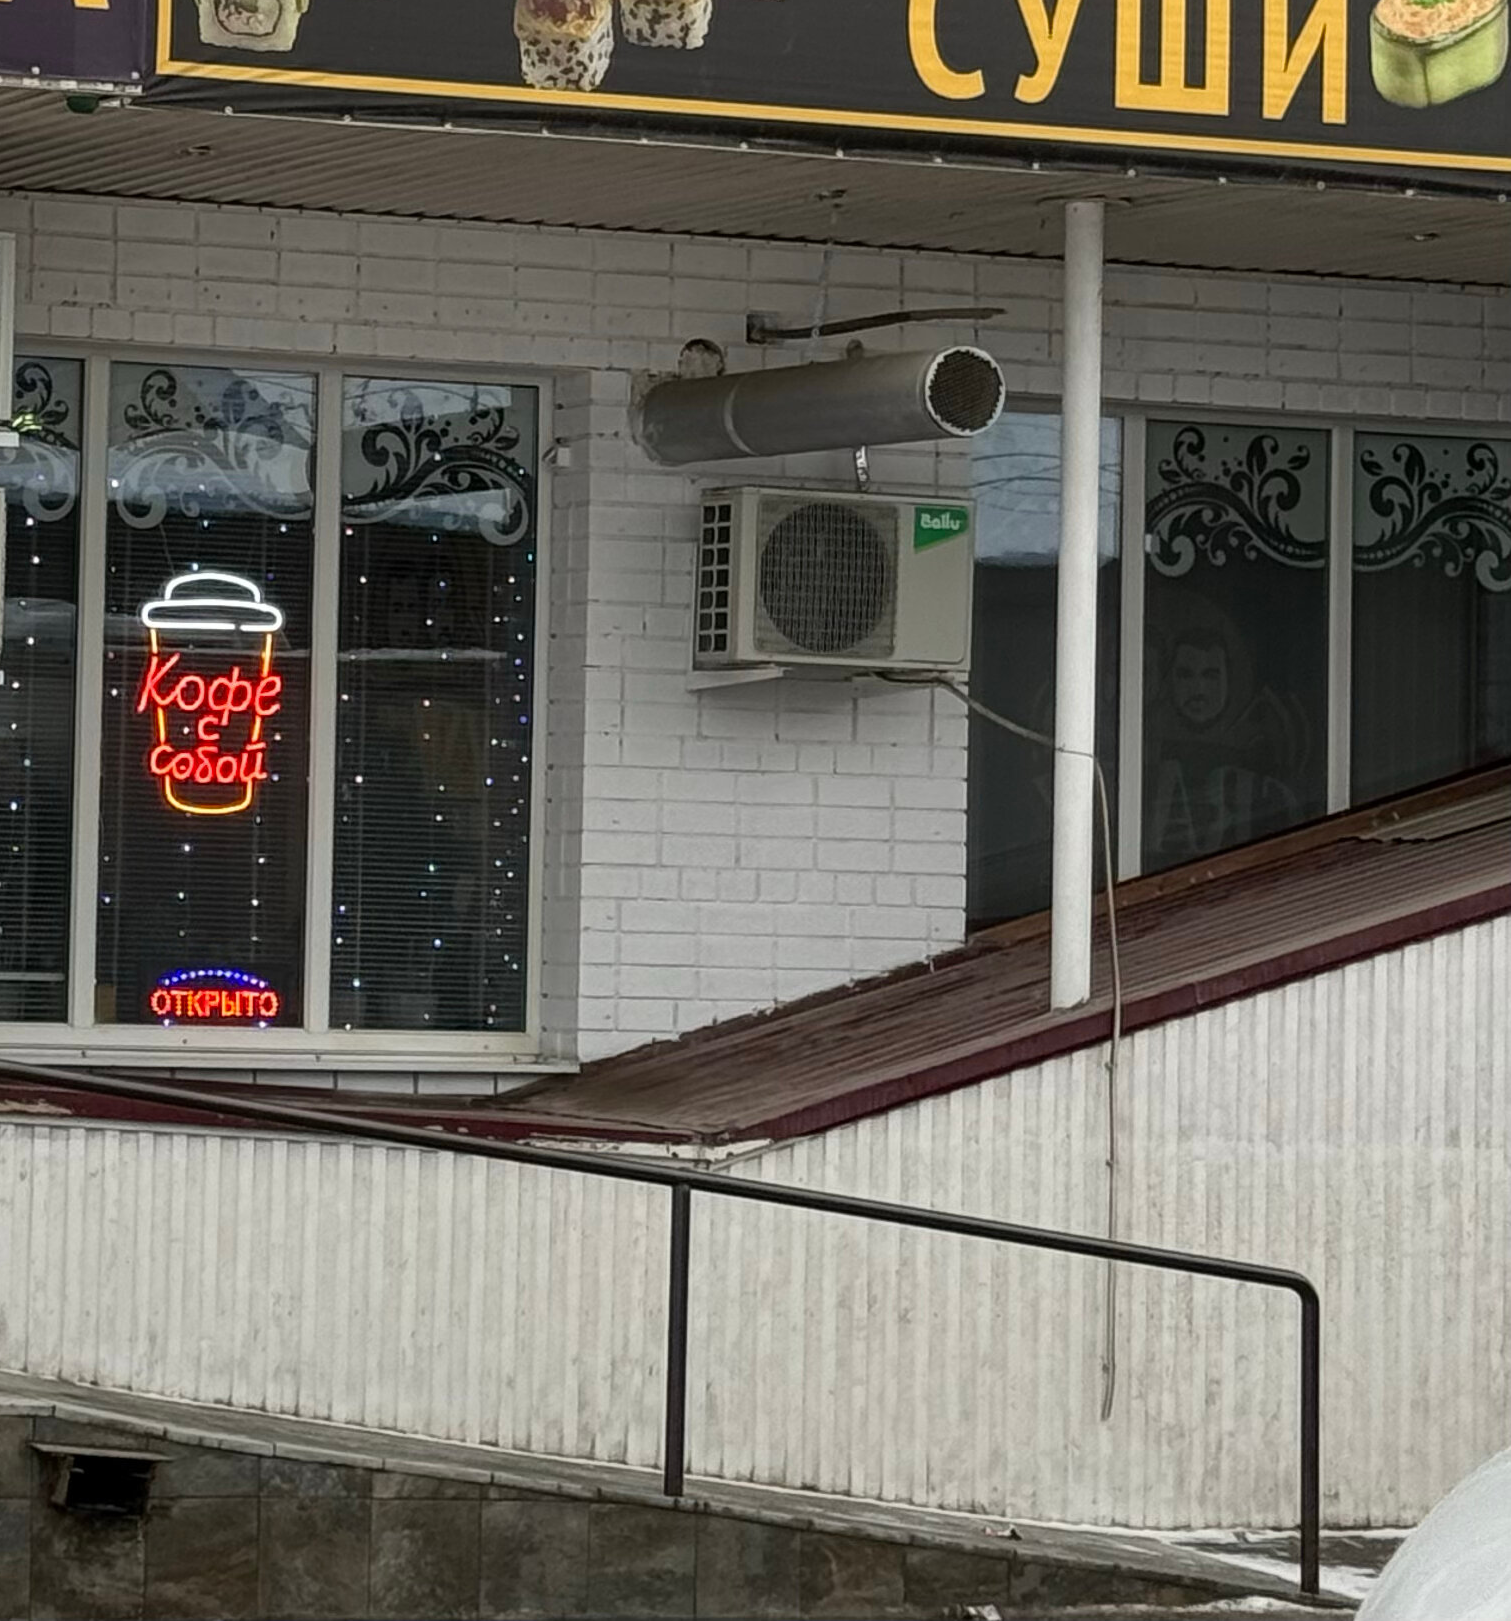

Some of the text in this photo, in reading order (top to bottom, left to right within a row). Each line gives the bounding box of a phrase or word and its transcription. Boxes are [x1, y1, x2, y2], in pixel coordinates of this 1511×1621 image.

[920, 513, 962, 531] Ballu
[137, 652, 281, 726] Кофе
[198, 716, 220, 740] с
[150, 742, 268, 783] собой
[151, 989, 279, 1018] ОТКРЫТО
